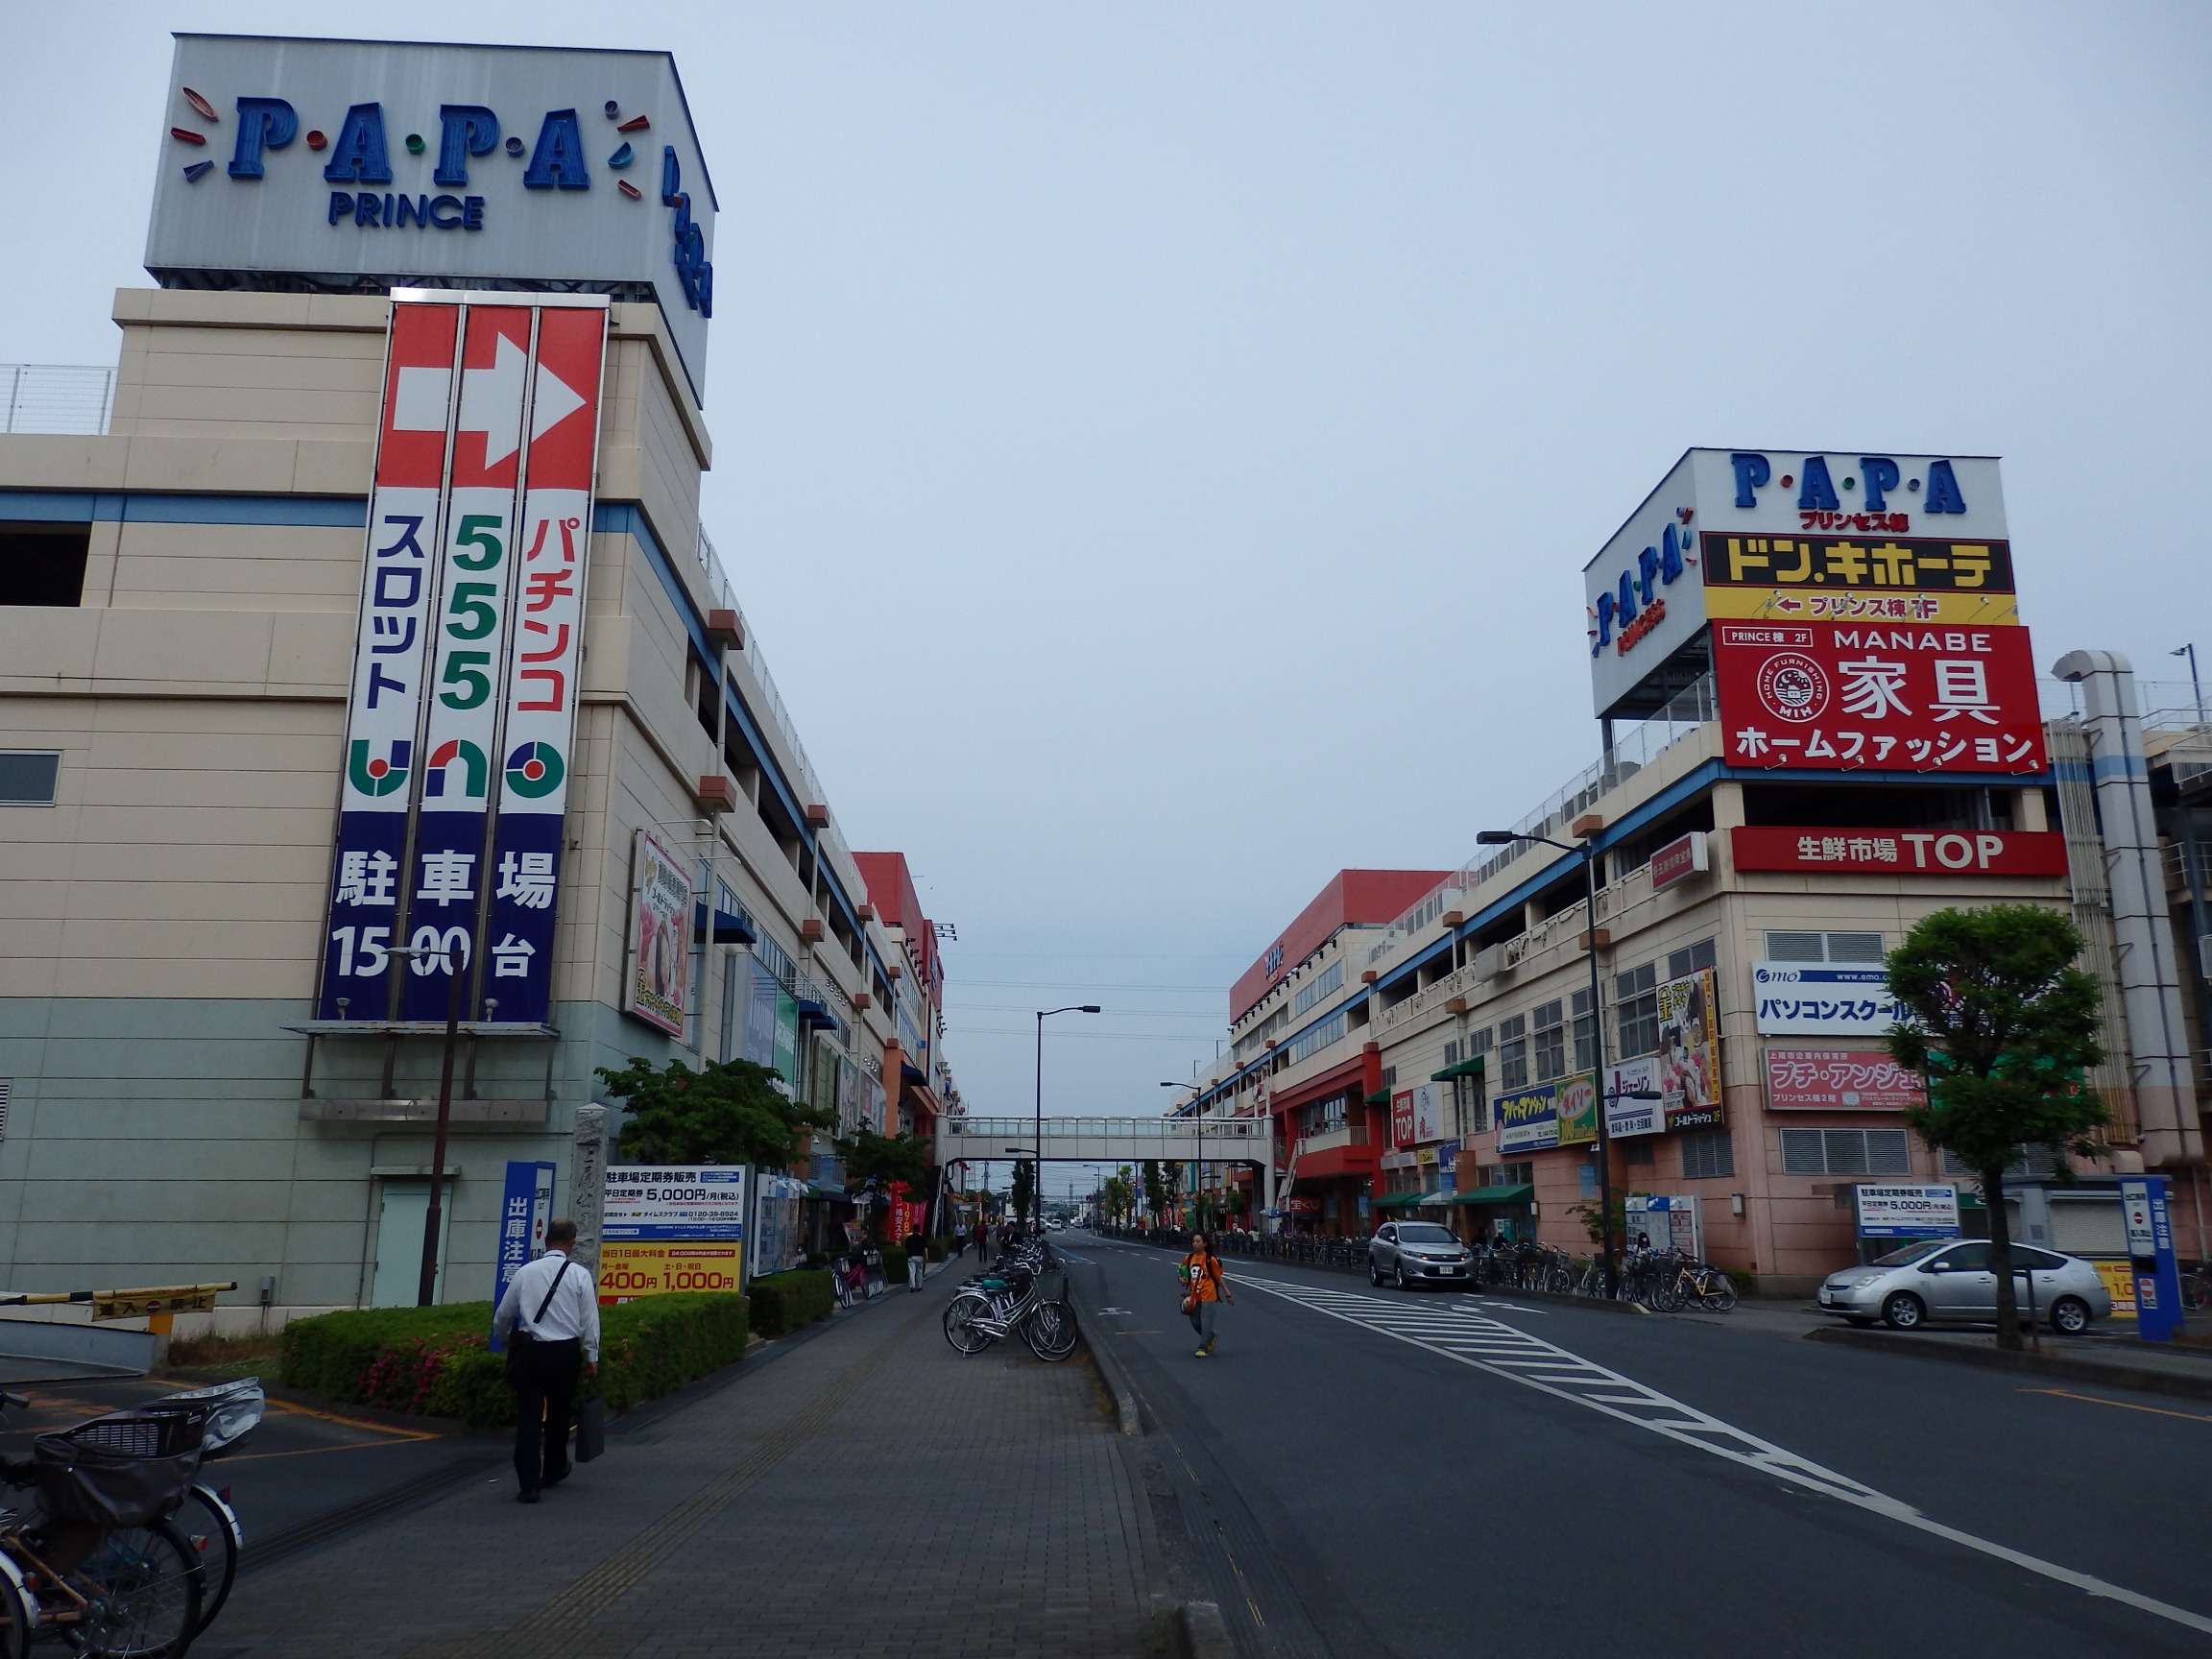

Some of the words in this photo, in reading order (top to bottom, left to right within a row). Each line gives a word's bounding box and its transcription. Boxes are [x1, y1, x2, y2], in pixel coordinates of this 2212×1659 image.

[327, 191, 486, 231] PRINCE
[367, 515, 425, 709] スロット
[439, 515, 503, 710] 555
[517, 517, 581, 712] パチンコ
[1809, 596, 1907, 618] プリンス棟
[1794, 634, 1808, 643] 2F
[1834, 630, 1993, 653] MANABE
[1763, 668, 1784, 700] HOME
[1773, 658, 1824, 700] FURNISHING
[1838, 655, 2002, 726] 家具
[1778, 705, 1814, 718] MIH
[1736, 725, 2034, 764] ホームファッション
[1796, 836, 1898, 862] 生鮮市場
[1902, 833, 2004, 869] TOP
[336, 849, 556, 909] 駐車場
[1760, 998, 1918, 1022] パソコンスクール
[1395, 1116, 1413, 1142] TOP
[605, 1171, 697, 1183] 駐車場定期券販売
[501, 1196, 529, 1284] 出庫注意
[602, 1249, 665, 1258] 当日1日最大料金
[599, 1272, 658, 1289] 400円
[662, 1272, 734, 1292] 1,000円
